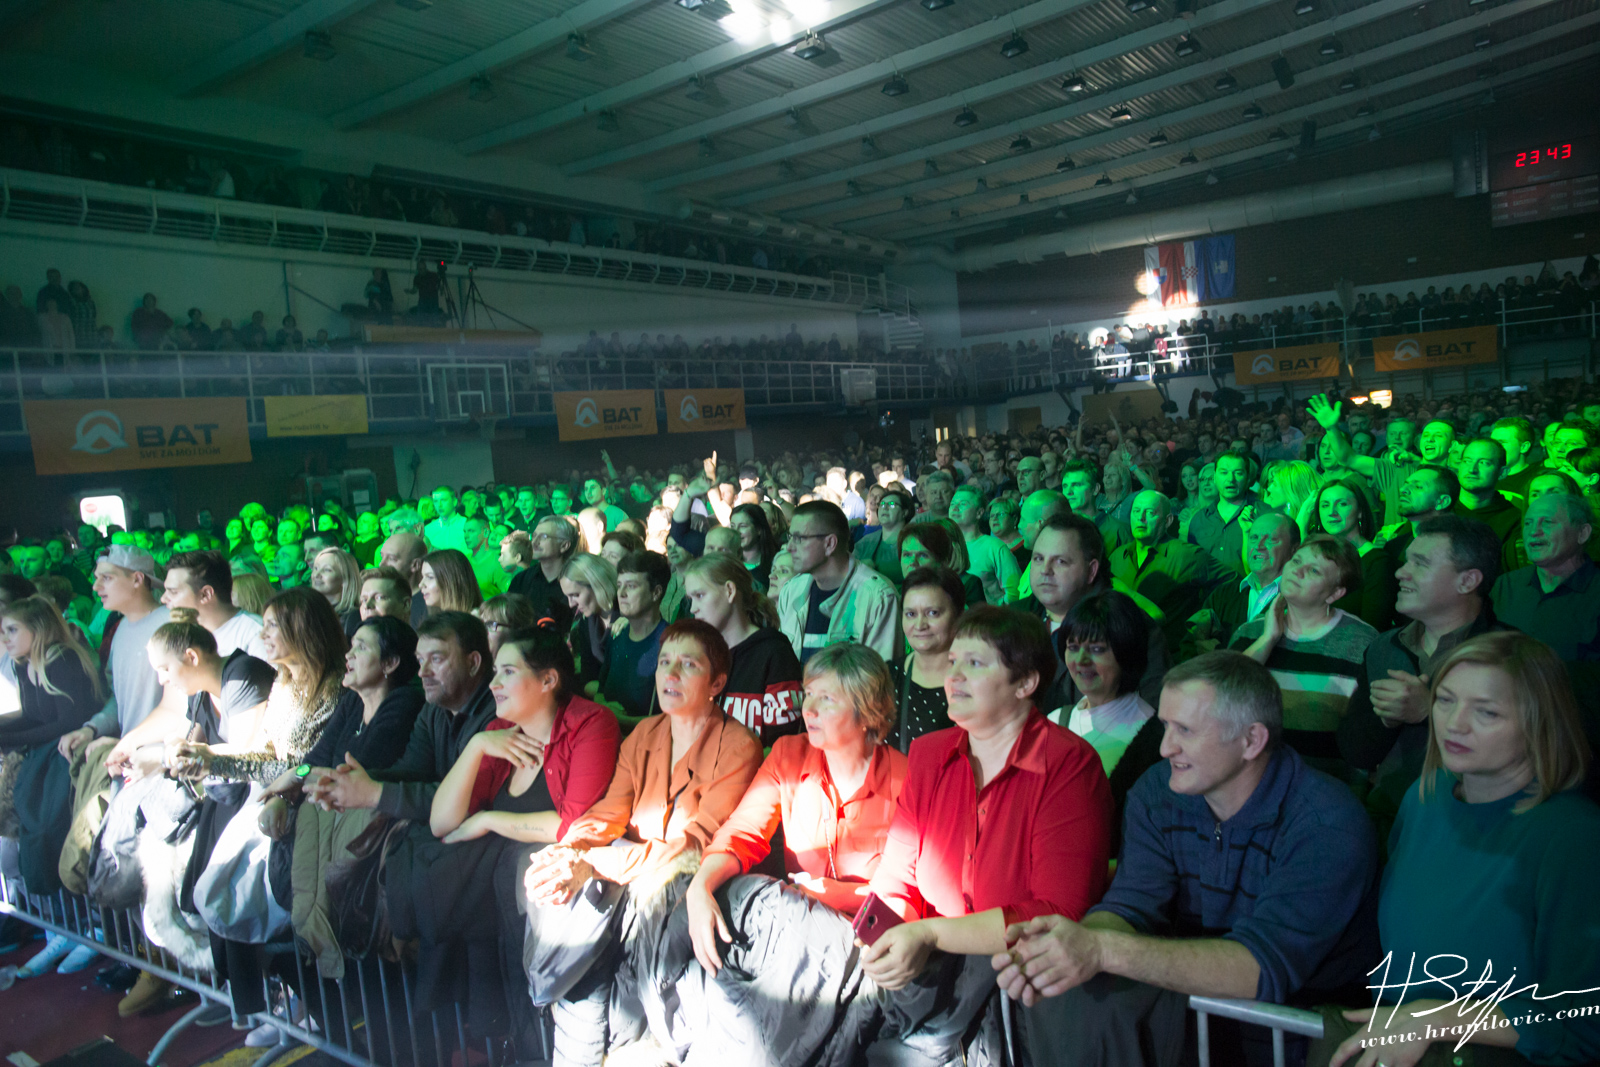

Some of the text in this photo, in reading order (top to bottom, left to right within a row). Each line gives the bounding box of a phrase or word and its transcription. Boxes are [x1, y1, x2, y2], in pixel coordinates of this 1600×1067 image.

[1426, 341, 1477, 356] BAT
[1279, 357, 1322, 371] BAT
[603, 407, 642, 423] BAT
[702, 404, 735, 418] BAT
[136, 423, 219, 447] BAT
[161, 448, 174, 457] ZA
